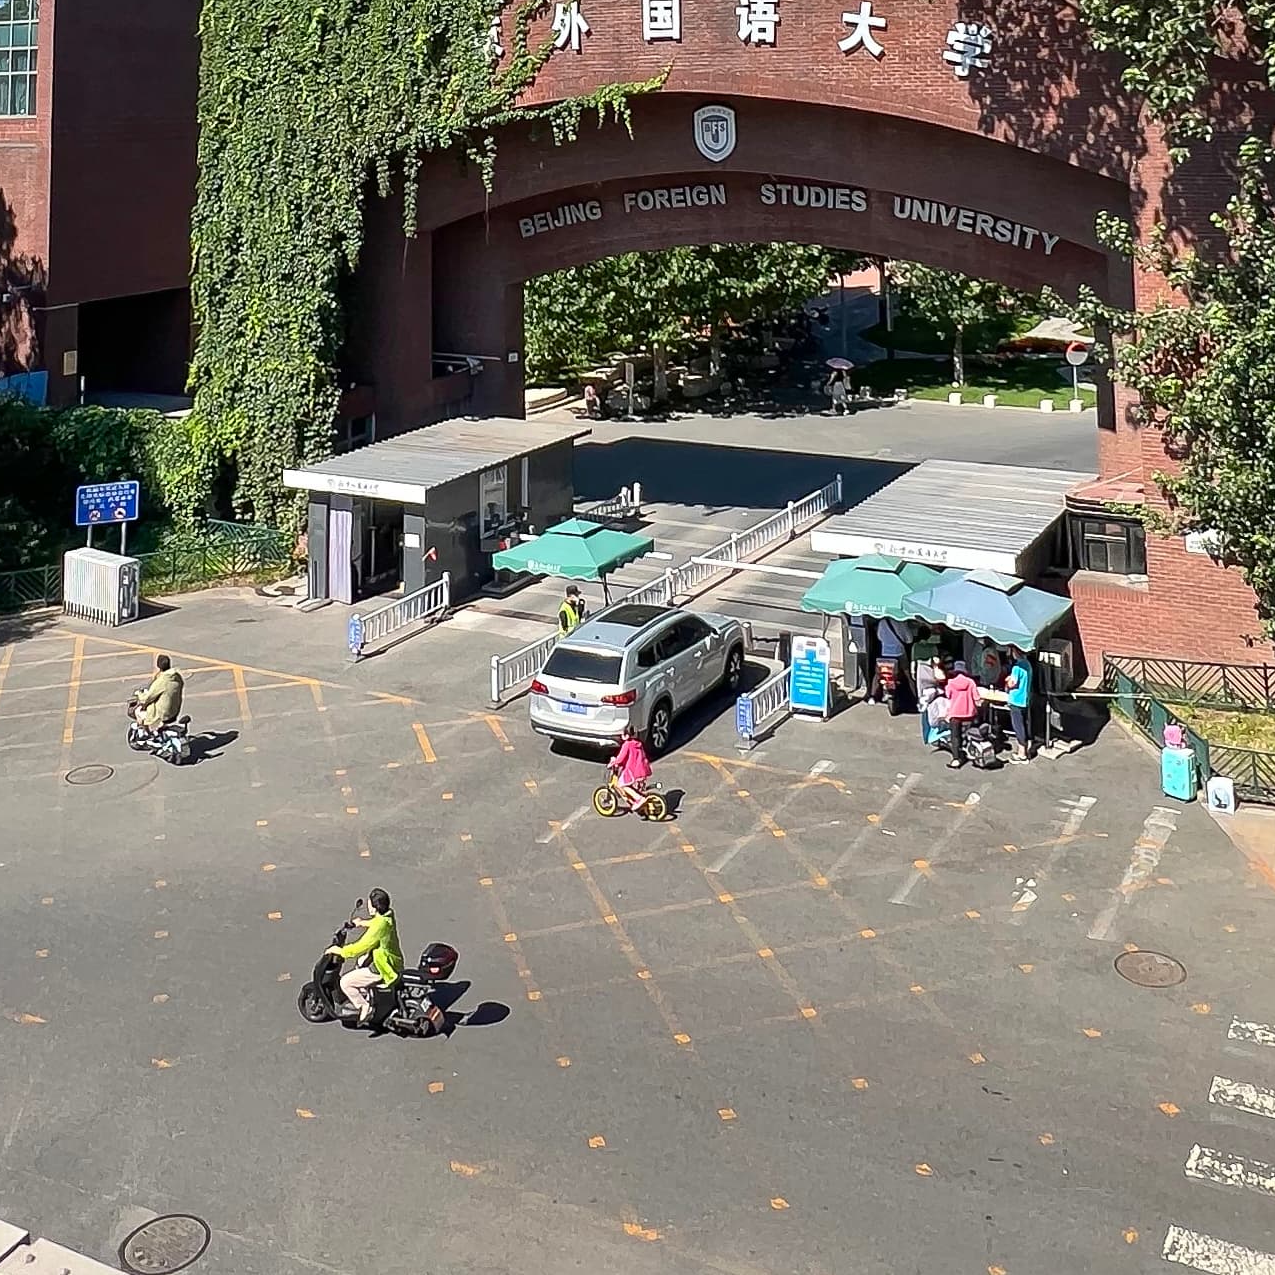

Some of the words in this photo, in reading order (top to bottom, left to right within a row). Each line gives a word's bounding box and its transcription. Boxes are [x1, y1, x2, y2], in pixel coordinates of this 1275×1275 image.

[518, 200, 602, 239] BEIJING
[623, 183, 728, 214] FOREIGN
[760, 183, 868, 213] STUDIES
[893, 195, 1061, 256] UNIVERSITY
